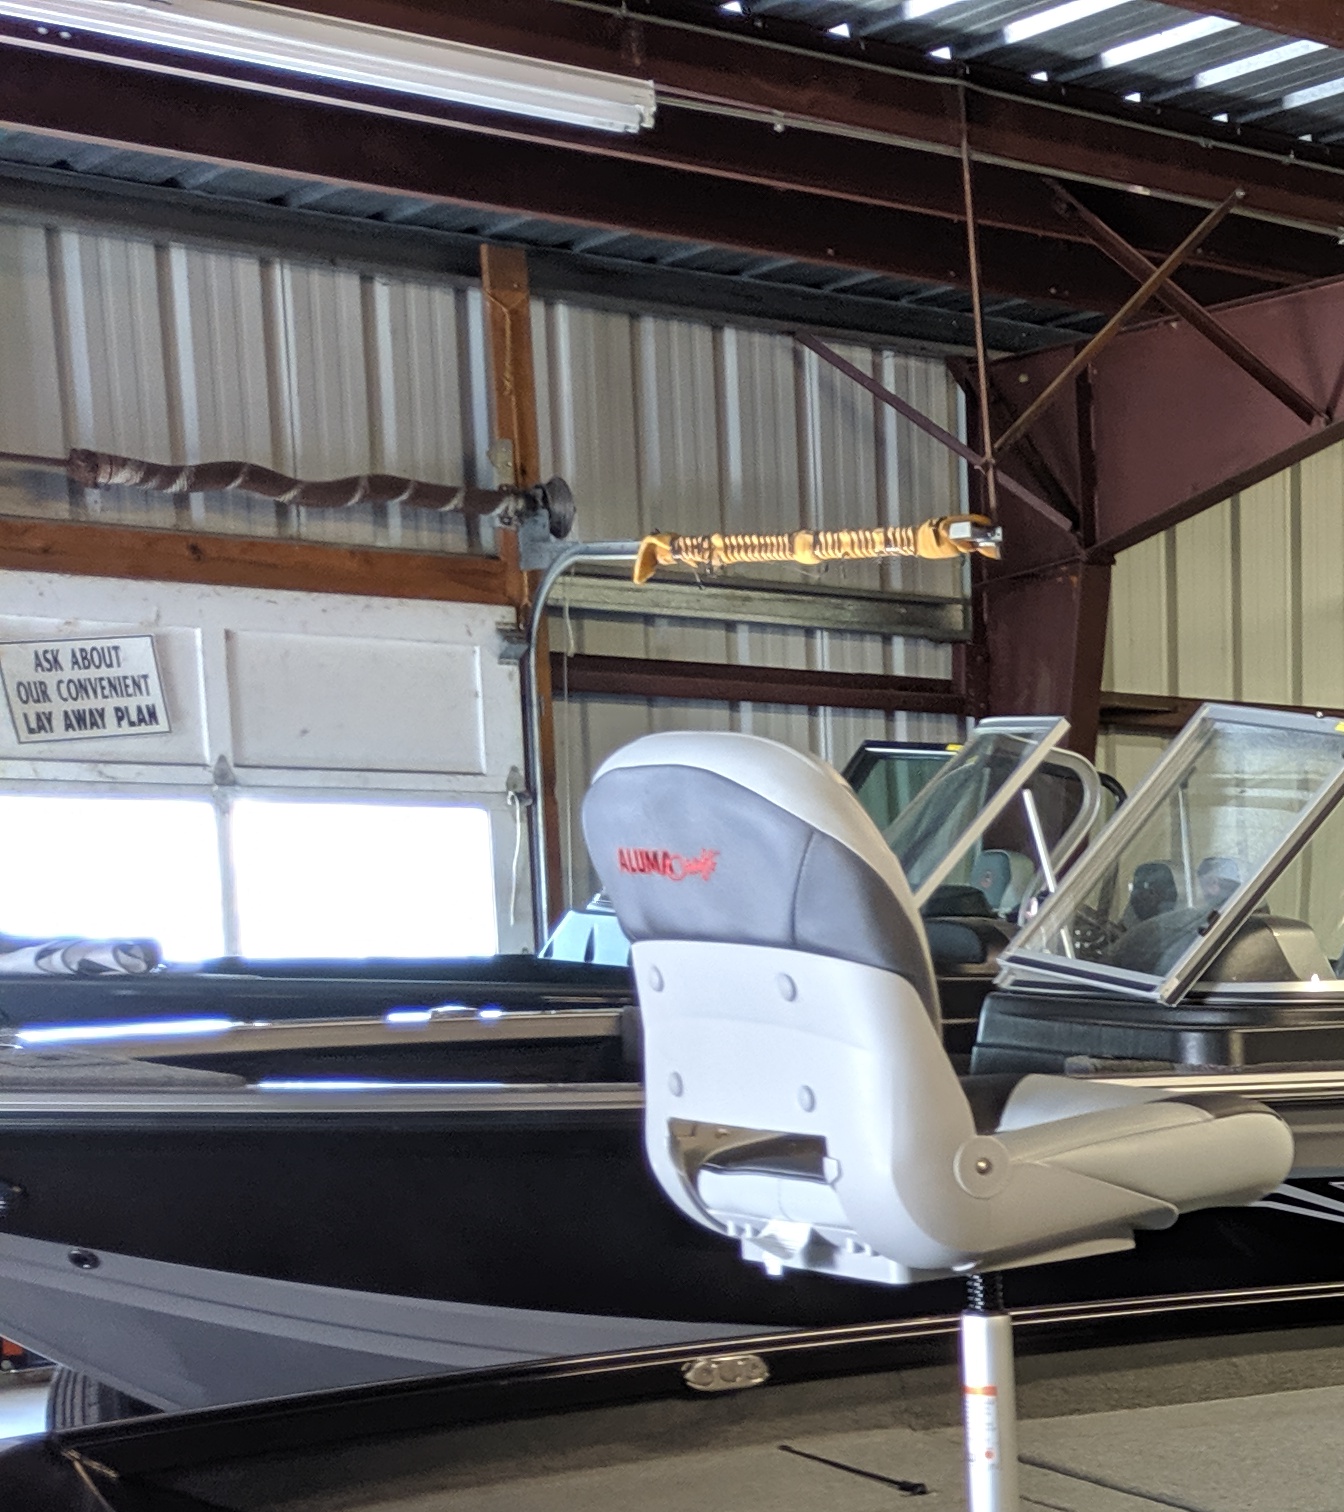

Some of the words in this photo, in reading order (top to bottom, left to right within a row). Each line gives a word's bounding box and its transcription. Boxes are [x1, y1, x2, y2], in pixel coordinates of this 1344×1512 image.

[33, 649, 64, 673] ASK
[71, 645, 122, 671] ABOUT
[16, 681, 52, 704] OUR
[56, 674, 151, 702] CONVENIENT
[22, 710, 54, 735] LAY
[63, 707, 107, 732] AWAY
[113, 703, 160, 728] PLAN
